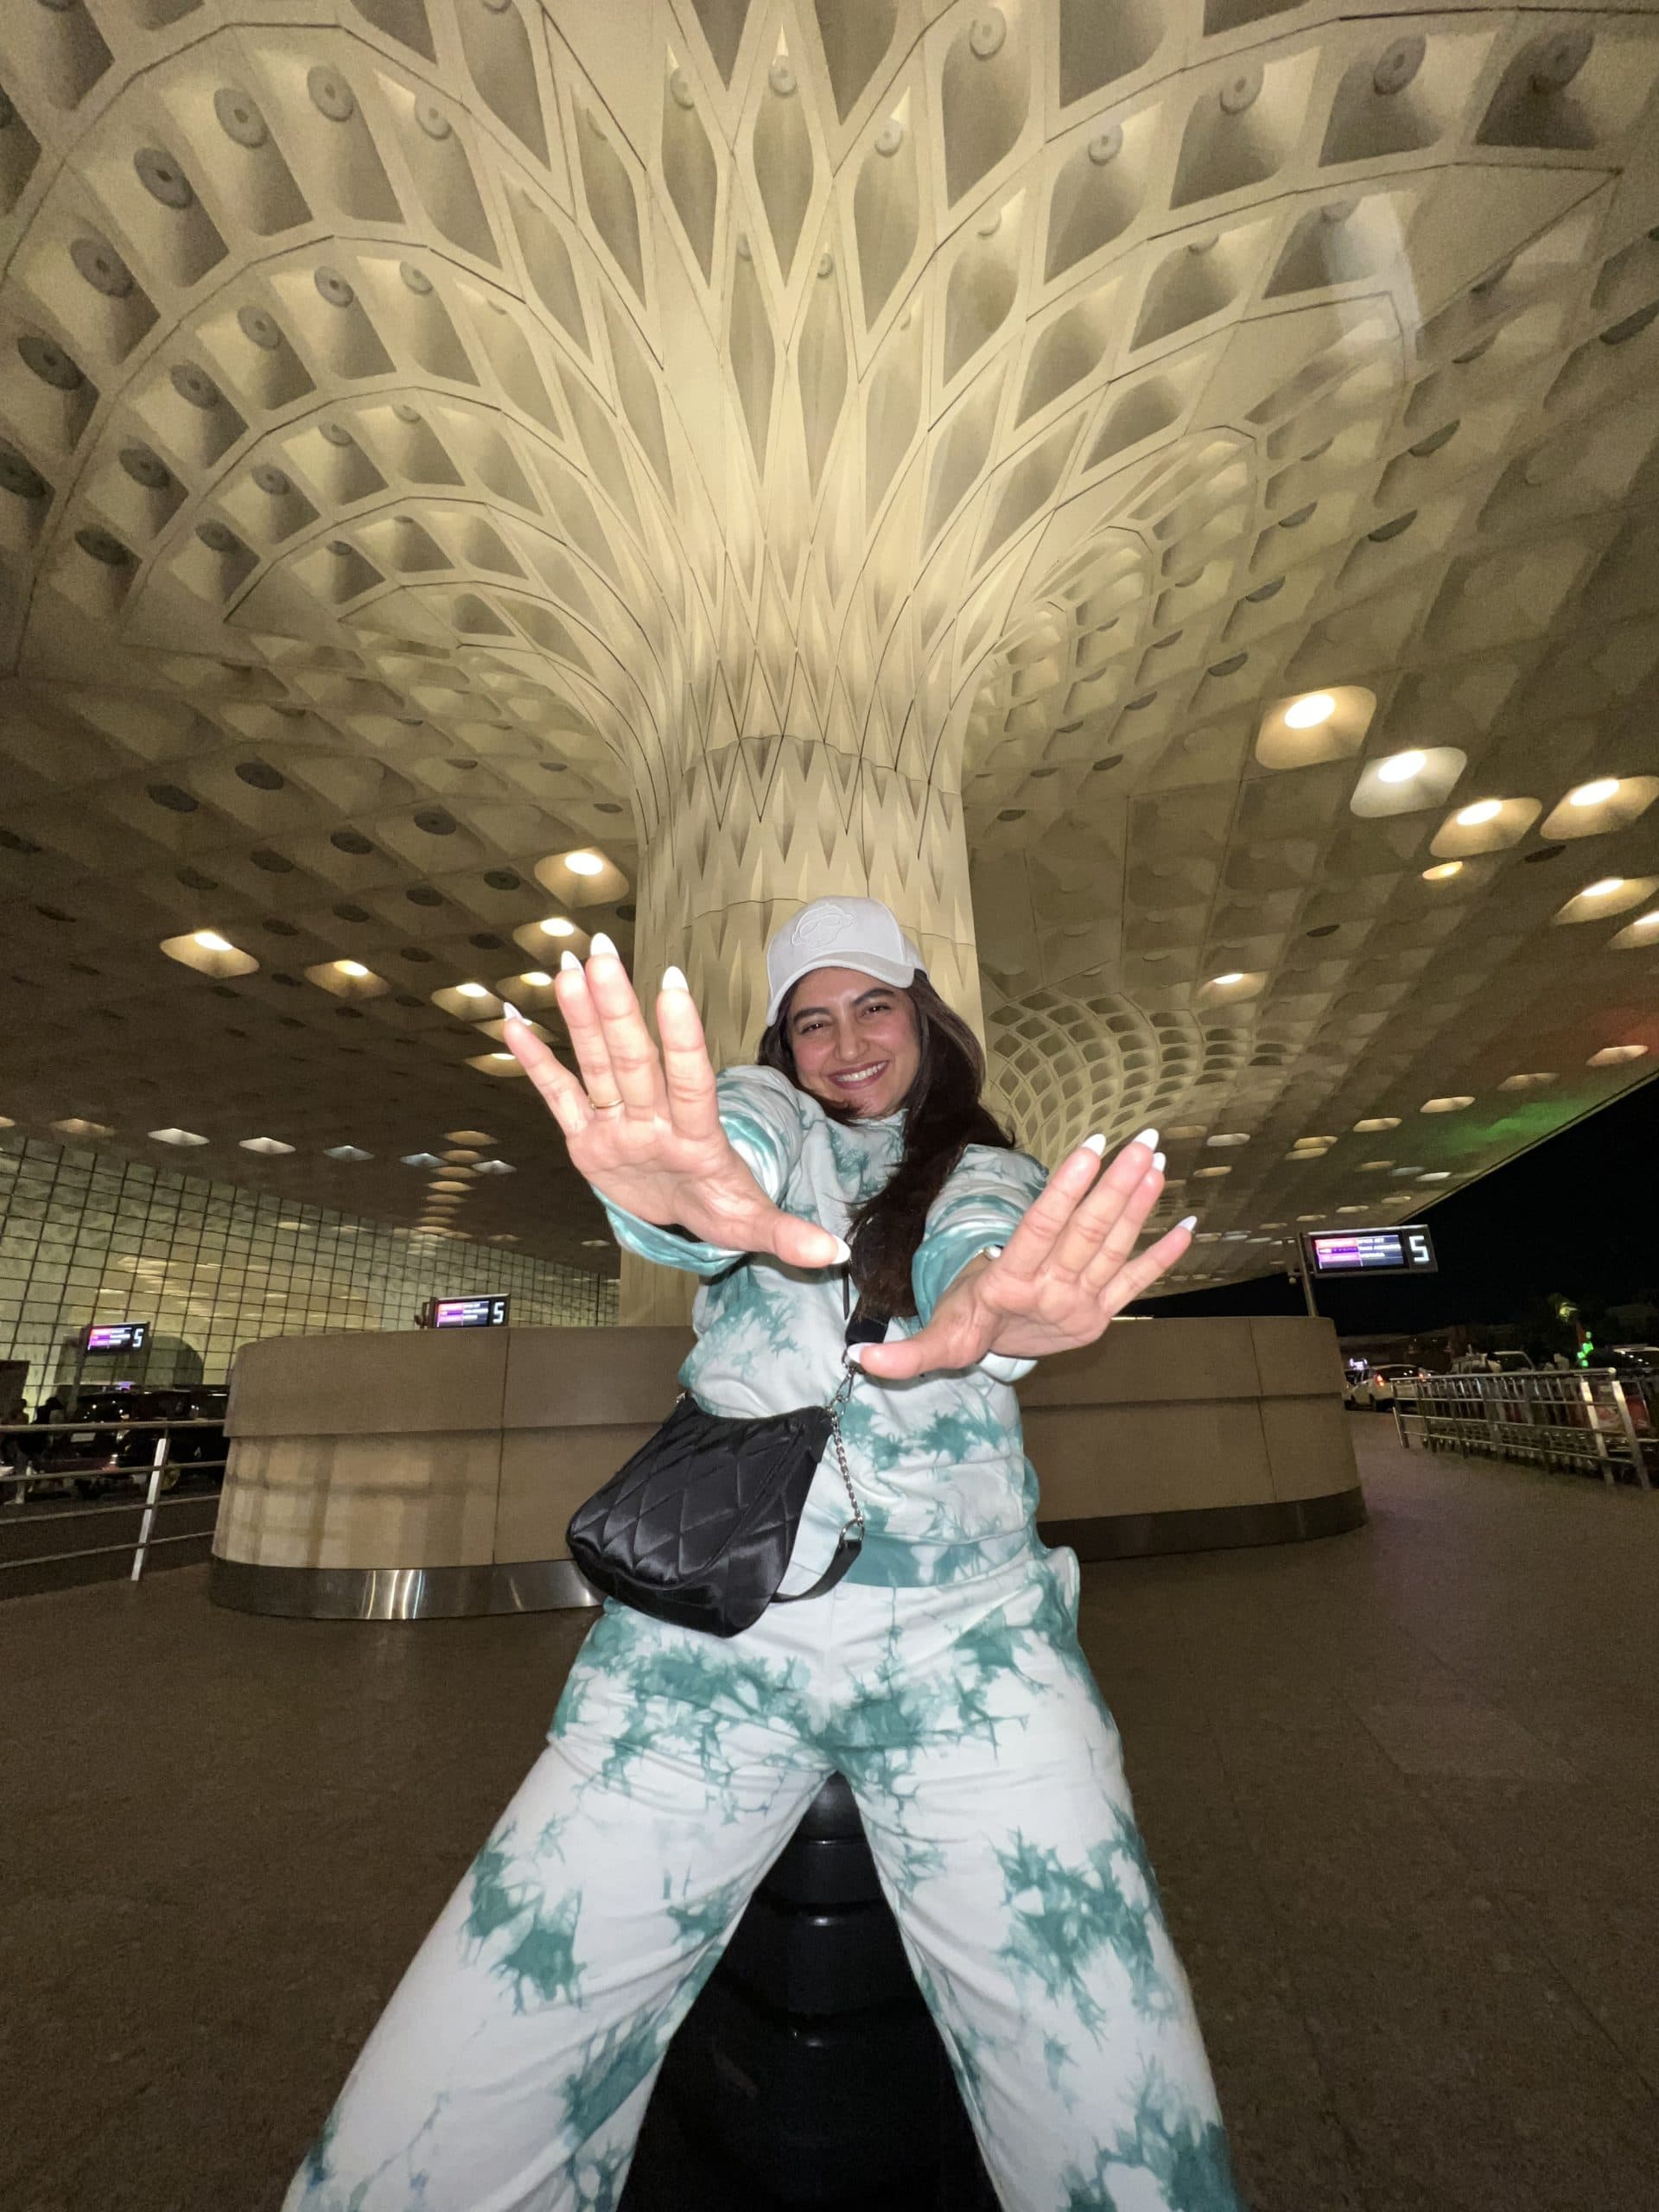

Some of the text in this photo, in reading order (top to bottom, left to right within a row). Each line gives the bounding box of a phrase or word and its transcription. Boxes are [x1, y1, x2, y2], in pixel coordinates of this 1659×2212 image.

[1409, 1235, 1430, 1262] 5
[493, 1301, 505, 1324] 5
[132, 1328, 144, 1348] 5
